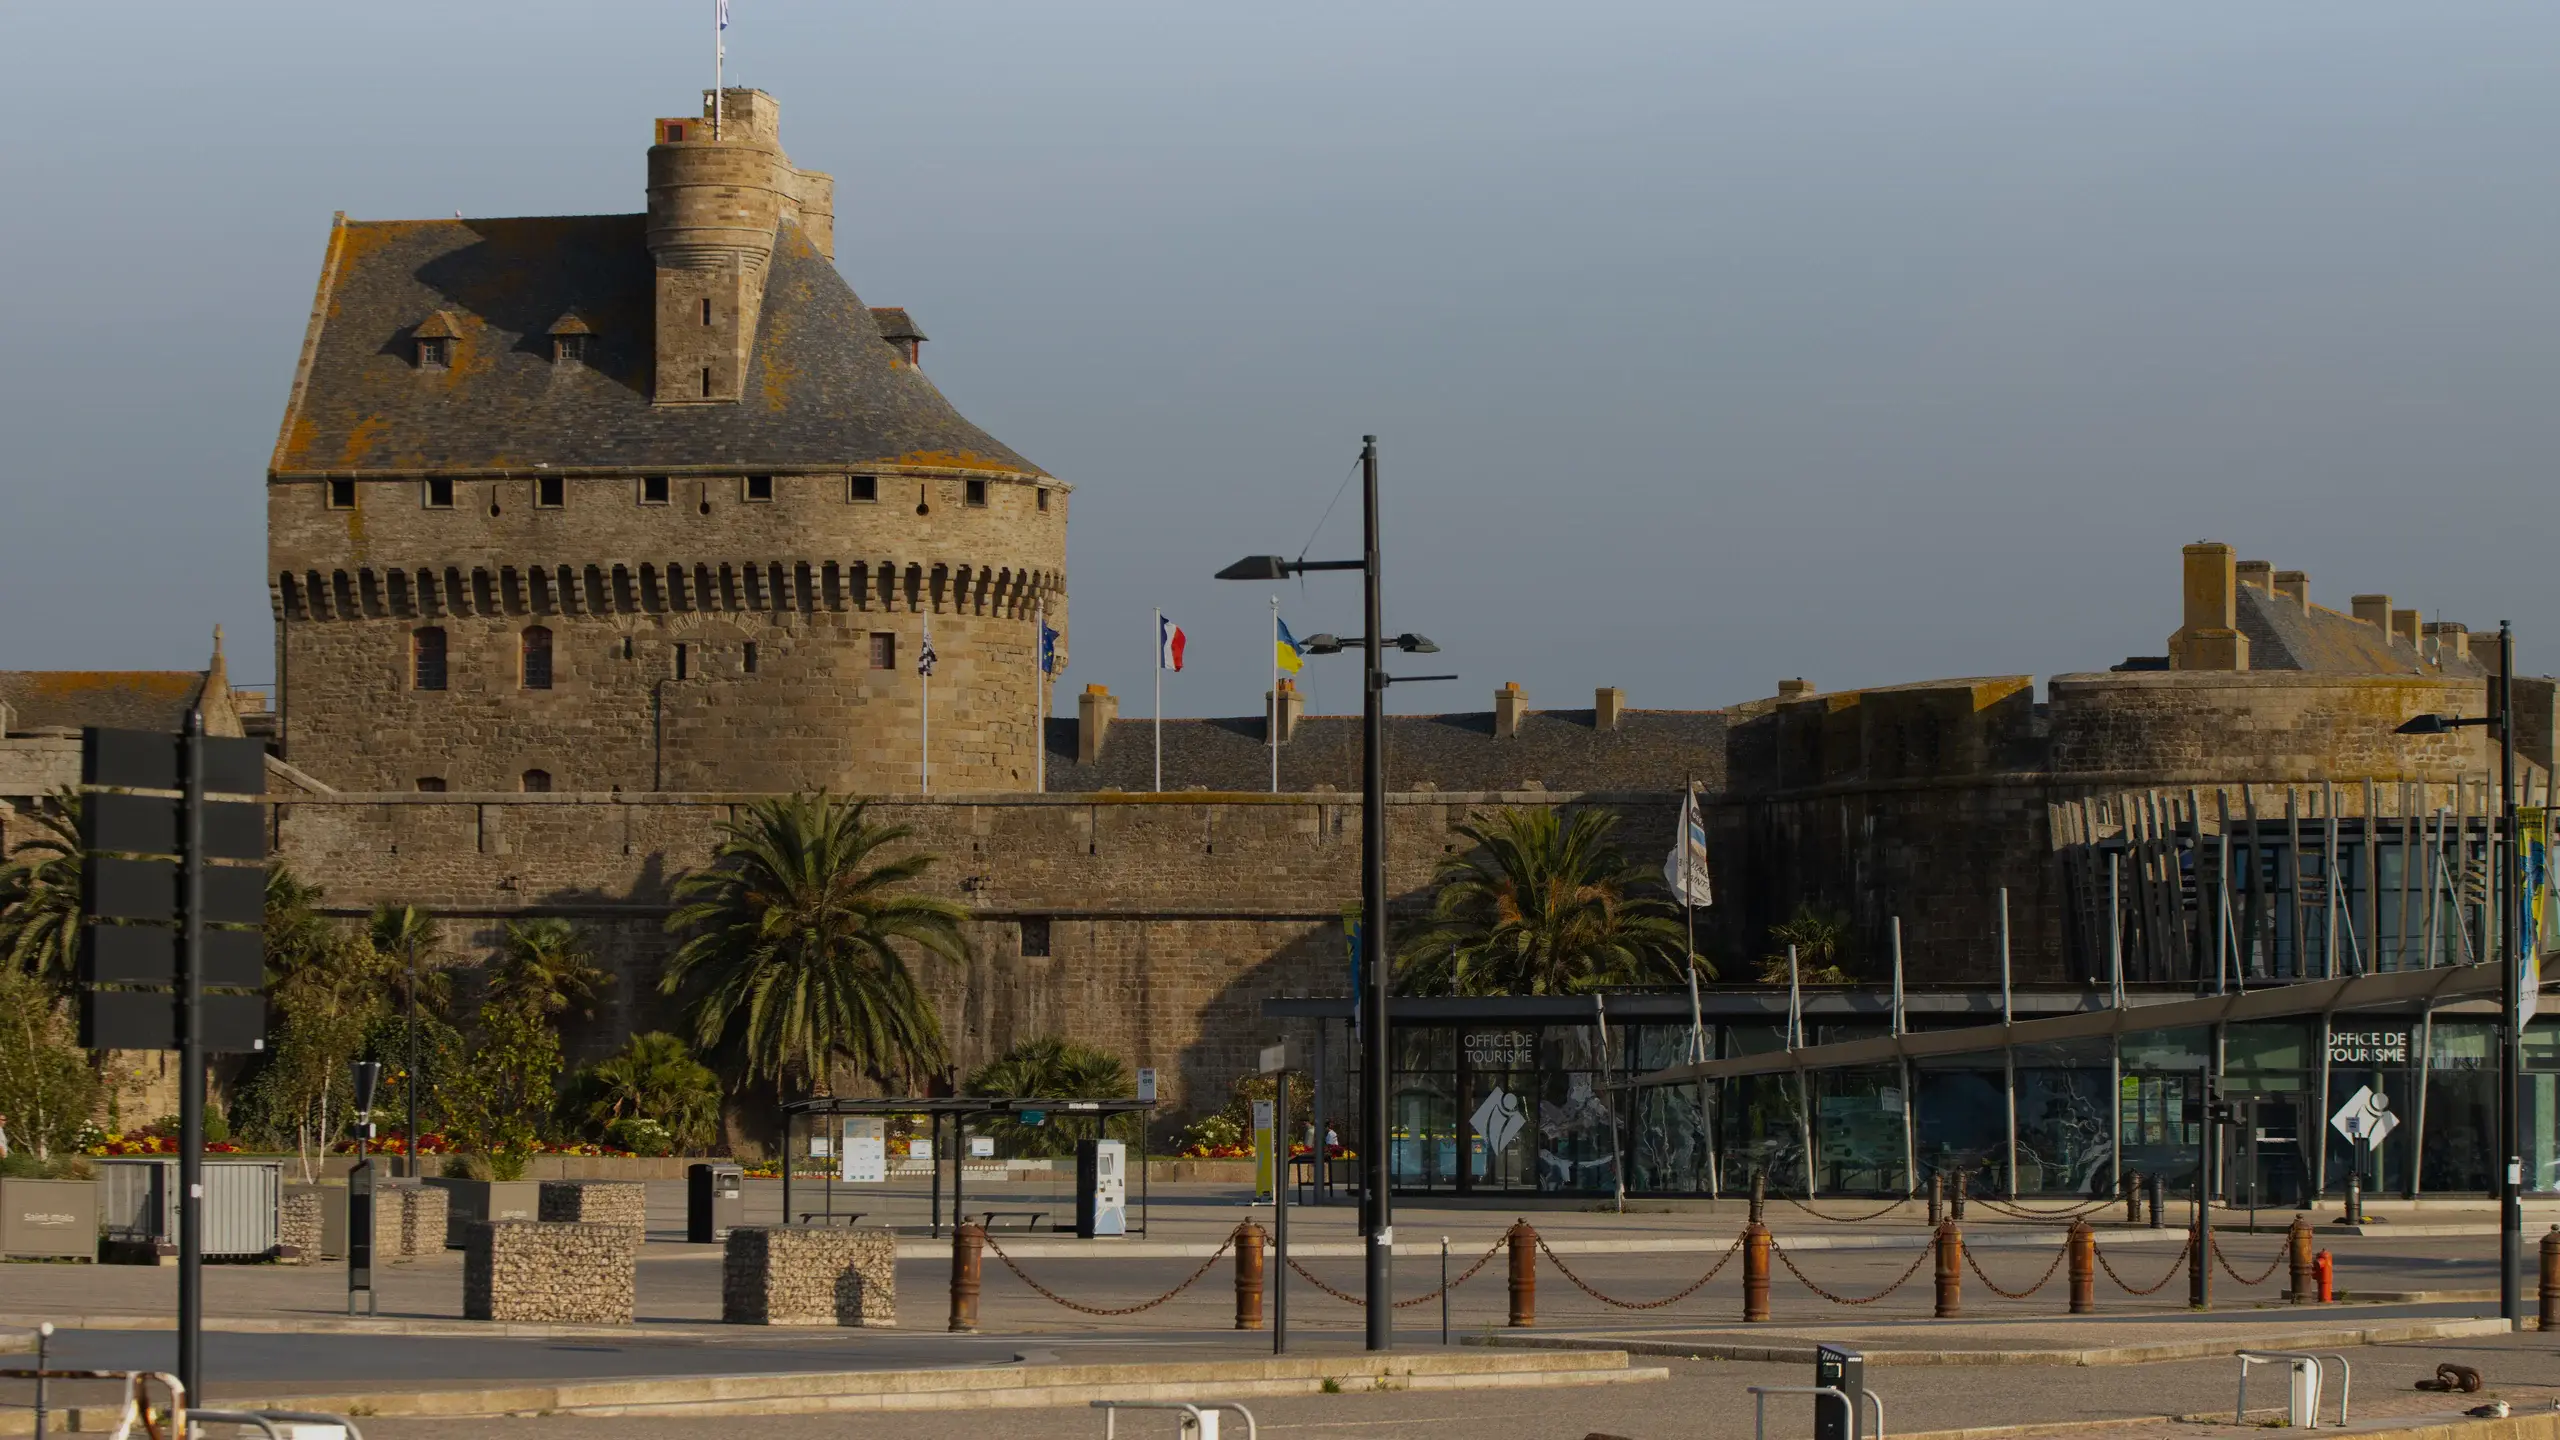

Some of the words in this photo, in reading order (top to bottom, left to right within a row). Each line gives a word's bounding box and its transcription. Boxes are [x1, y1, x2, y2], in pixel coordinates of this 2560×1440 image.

[1464, 1034, 1511, 1047] OFFICE
[1515, 1034, 1533, 1047] DE
[2328, 1032, 2381, 1046] OFFICE
[2384, 1032, 2407, 1046] DE
[1464, 1050, 1532, 1063] TOURISME
[2328, 1048, 2406, 1062] TOURISME
